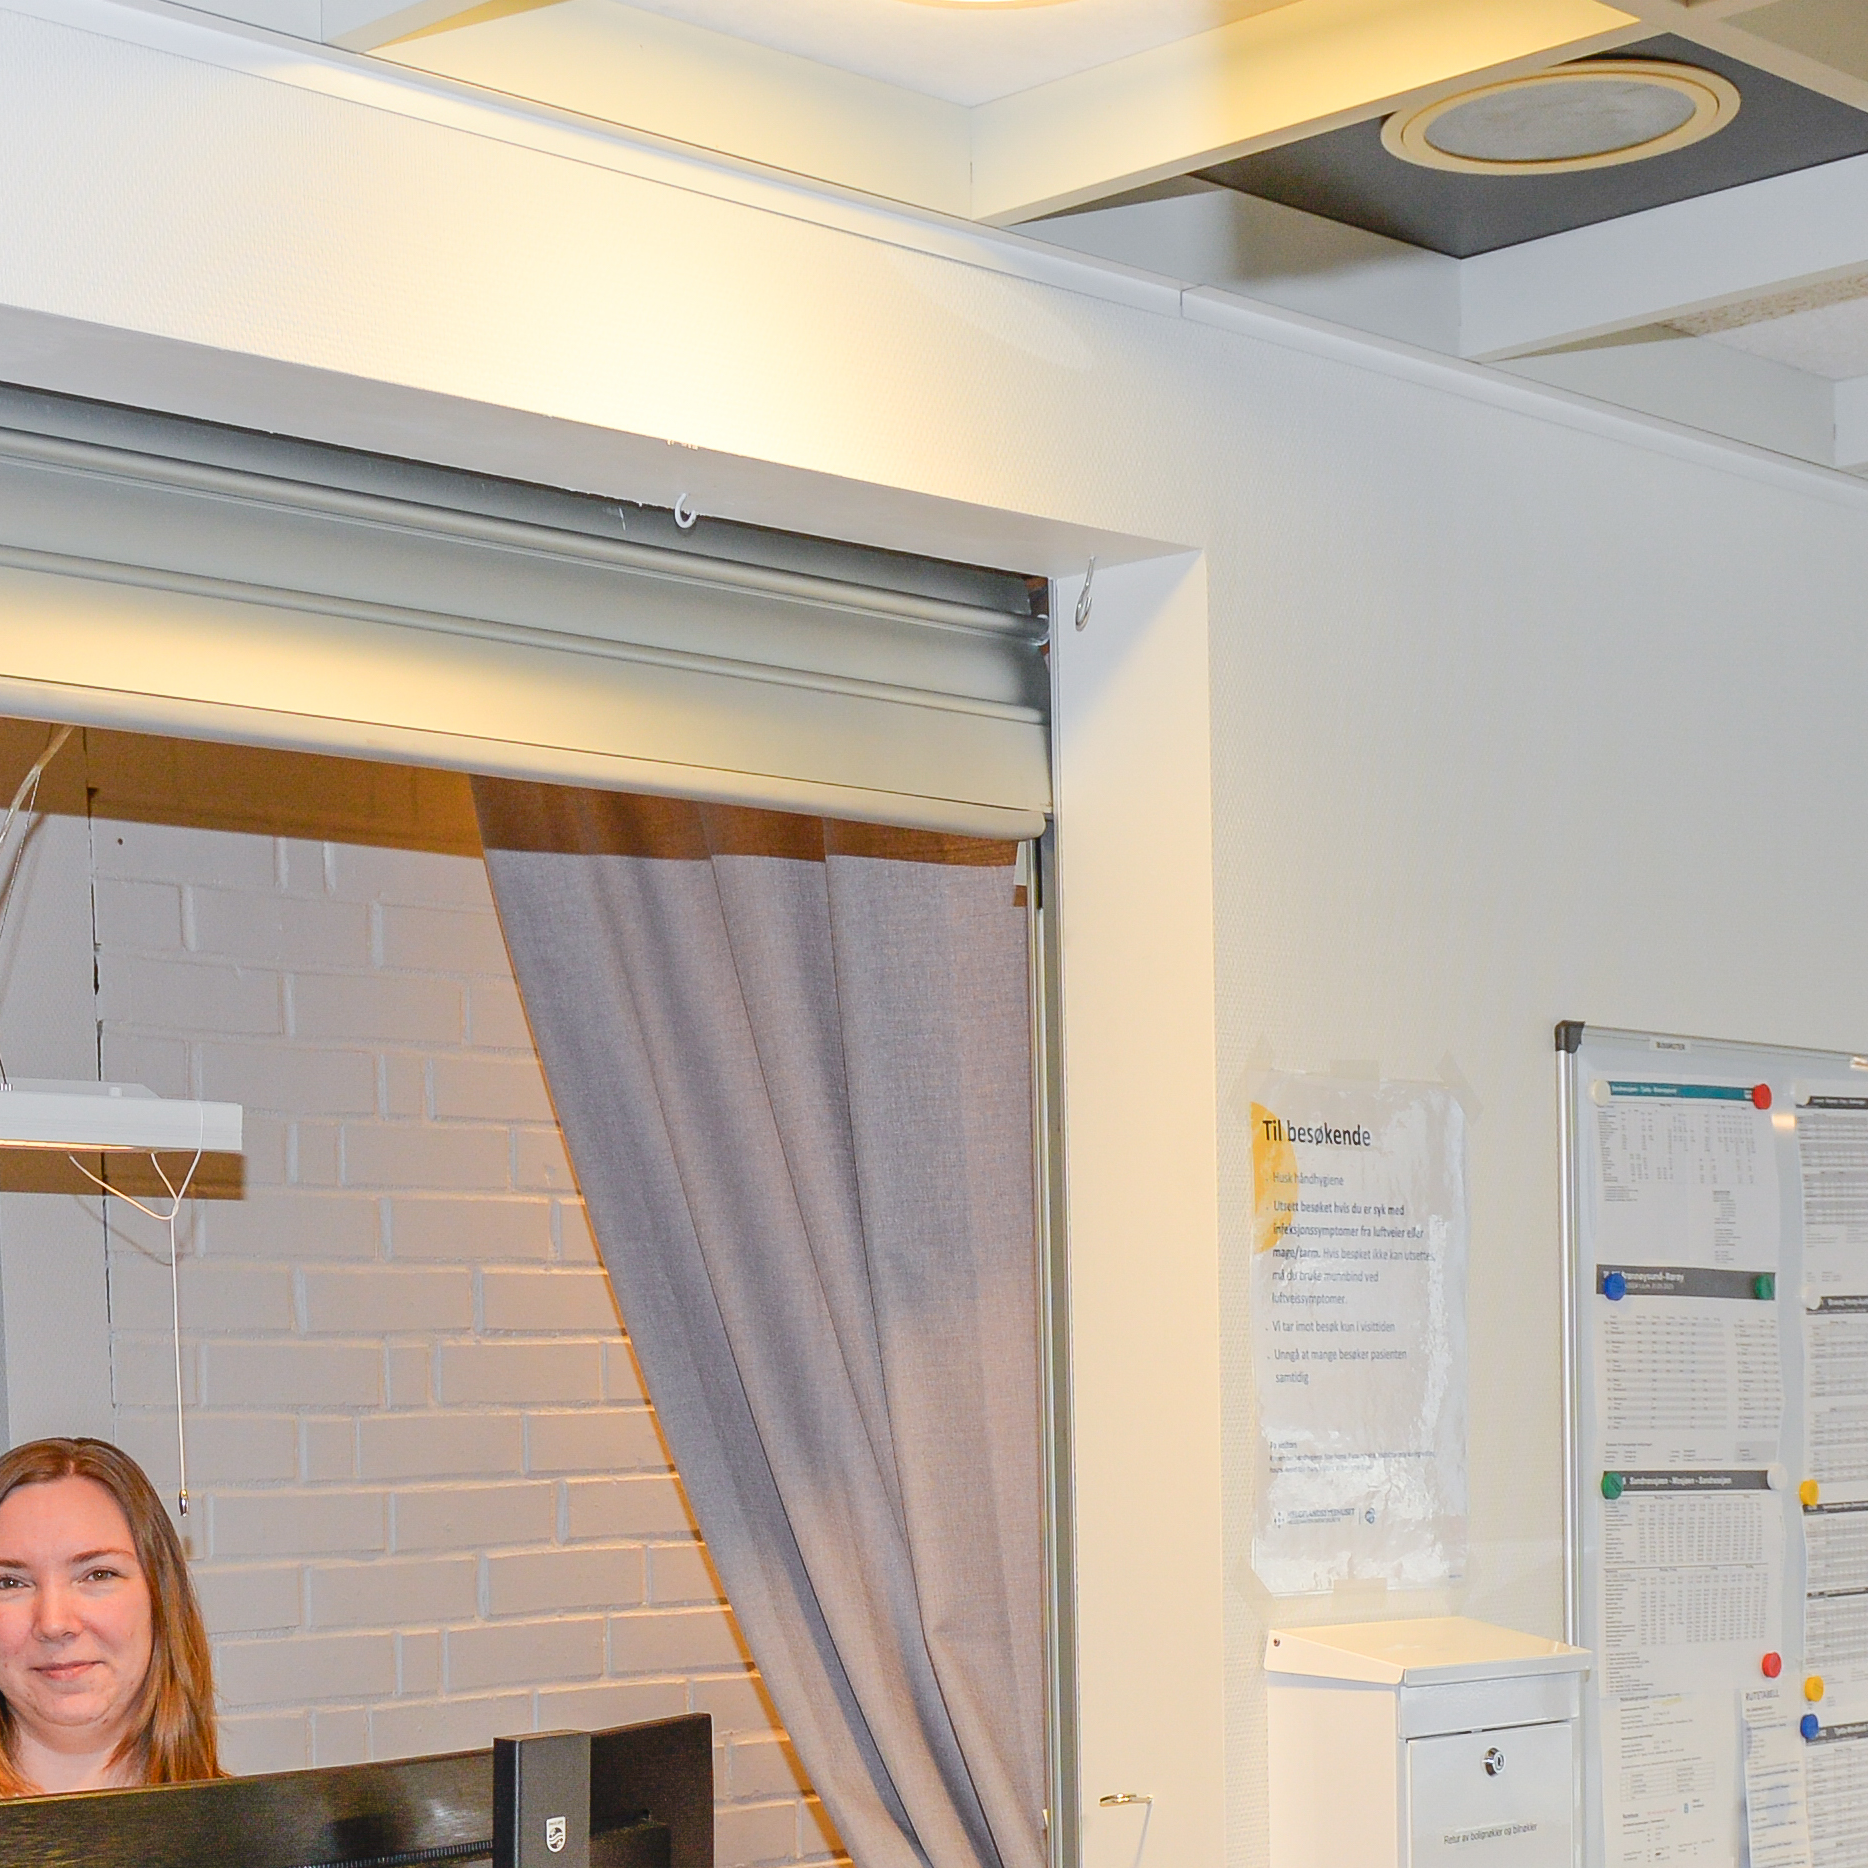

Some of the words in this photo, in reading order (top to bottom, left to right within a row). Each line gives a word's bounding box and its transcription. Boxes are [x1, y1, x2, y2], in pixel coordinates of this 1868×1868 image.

[1263, 1120, 1282, 1141] Til
[1288, 1120, 1371, 1146] besøkende
[1273, 1173, 1292, 1184] Husk
[1295, 1174, 1344, 1187] håndhygiene
[1274, 1200, 1298, 1212] Utsett
[1301, 1202, 1332, 1214] besøket
[1334, 1201, 1350, 1214] hvis
[1351, 1202, 1361, 1214] du
[1364, 1206, 1371, 1214] er
[1373, 1203, 1386, 1218] syk
[1388, 1204, 1404, 1215] med
[1273, 1223, 1359, 1239] infeksjonssymptomer
[1361, 1225, 1371, 1238] fra
[1373, 1225, 1405, 1238] luftveier
[1407, 1227, 1424, 1239] eller
[1273, 1246, 1320, 1261] mage/tarm.
[1323, 1248, 1340, 1259] Hvis
[1341, 1248, 1371, 1260] besøket
[1372, 1249, 1388, 1260] ikke
[1390, 1250, 1403, 1260] kan
[1272, 1270, 1286, 1282] må
[1288, 1270, 1298, 1282] du
[1299, 1270, 1322, 1282] bruke
[1324, 1271, 1363, 1282] munnbind
[1365, 1271, 1379, 1282] ved
[1272, 1321, 1281, 1332] Vi
[1283, 1322, 1294, 1332] tar
[1296, 1321, 1314, 1332] imot
[1316, 1321, 1339, 1332] besøk
[1341, 1321, 1355, 1333] kun
[1361, 1322, 1396, 1333] visittiden
[1274, 1349, 1299, 1363] Unngå
[1301, 1351, 1309, 1360] at
[1311, 1352, 1337, 1363] mange
[1339, 1350, 1370, 1361] besøker
[1371, 1350, 1407, 1362] pasienten
[1276, 1372, 1309, 1385] samtidig
[1444, 1835, 1460, 1844] Retur
[1462, 1834, 1469, 1842] av
[1504, 1828, 1511, 1836] og
